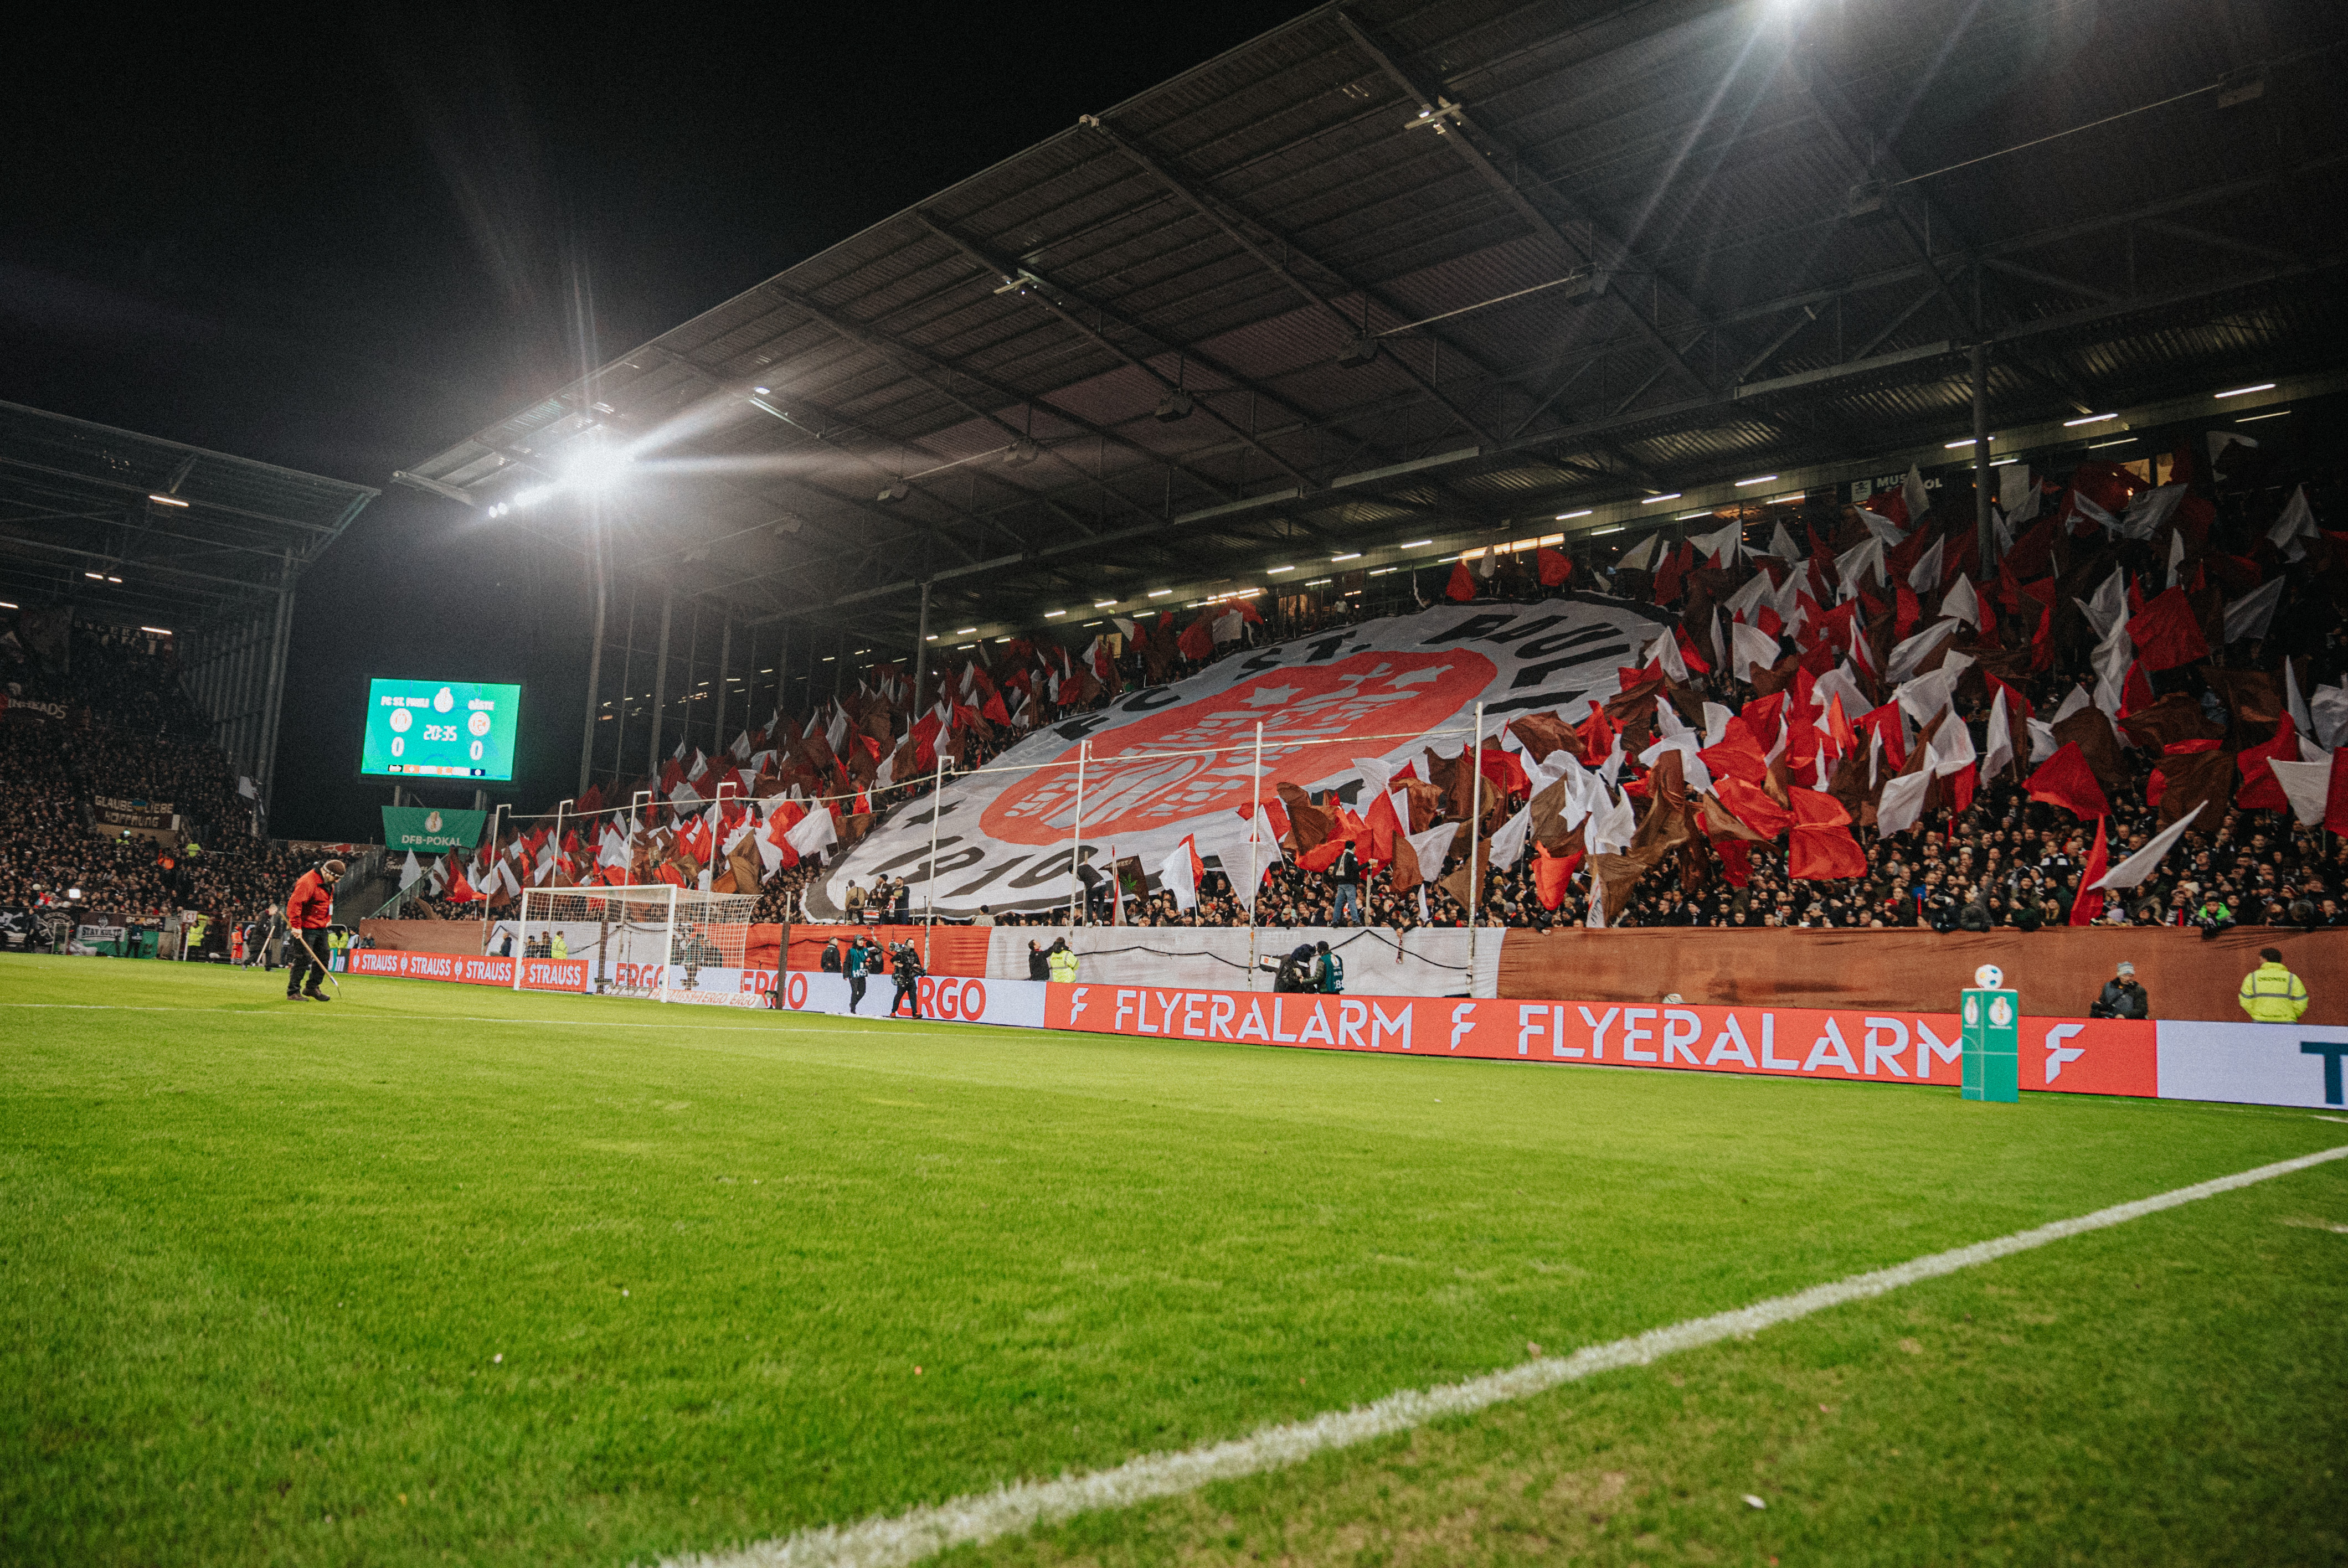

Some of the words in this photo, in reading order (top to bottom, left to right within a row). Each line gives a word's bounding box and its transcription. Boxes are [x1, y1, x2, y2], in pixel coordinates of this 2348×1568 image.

[1424, 613, 1631, 716] PAULI
[423, 724, 457, 741] 20:35
[391, 736, 405, 757] 0
[470, 740, 483, 760] 0
[95, 795, 133, 812] GLAUBE
[145, 802, 174, 814] LIEBE
[104, 811, 161, 828] HOFFNUNG
[401, 834, 462, 847] DFB-POKAL
[866, 835, 1099, 898] 1910
[81, 926, 98, 936] STAY
[362, 953, 398, 972] STRAUSS
[410, 956, 451, 977] STRAUSS
[466, 960, 512, 982] STRAUSS
[529, 963, 581, 986] STRAUSS
[703, 991, 729, 1004] ERGO
[729, 994, 757, 1007] ERGO
[1115, 989, 1413, 1049] FLYERALARM
[1518, 1004, 1962, 1079] FLYERALARM
